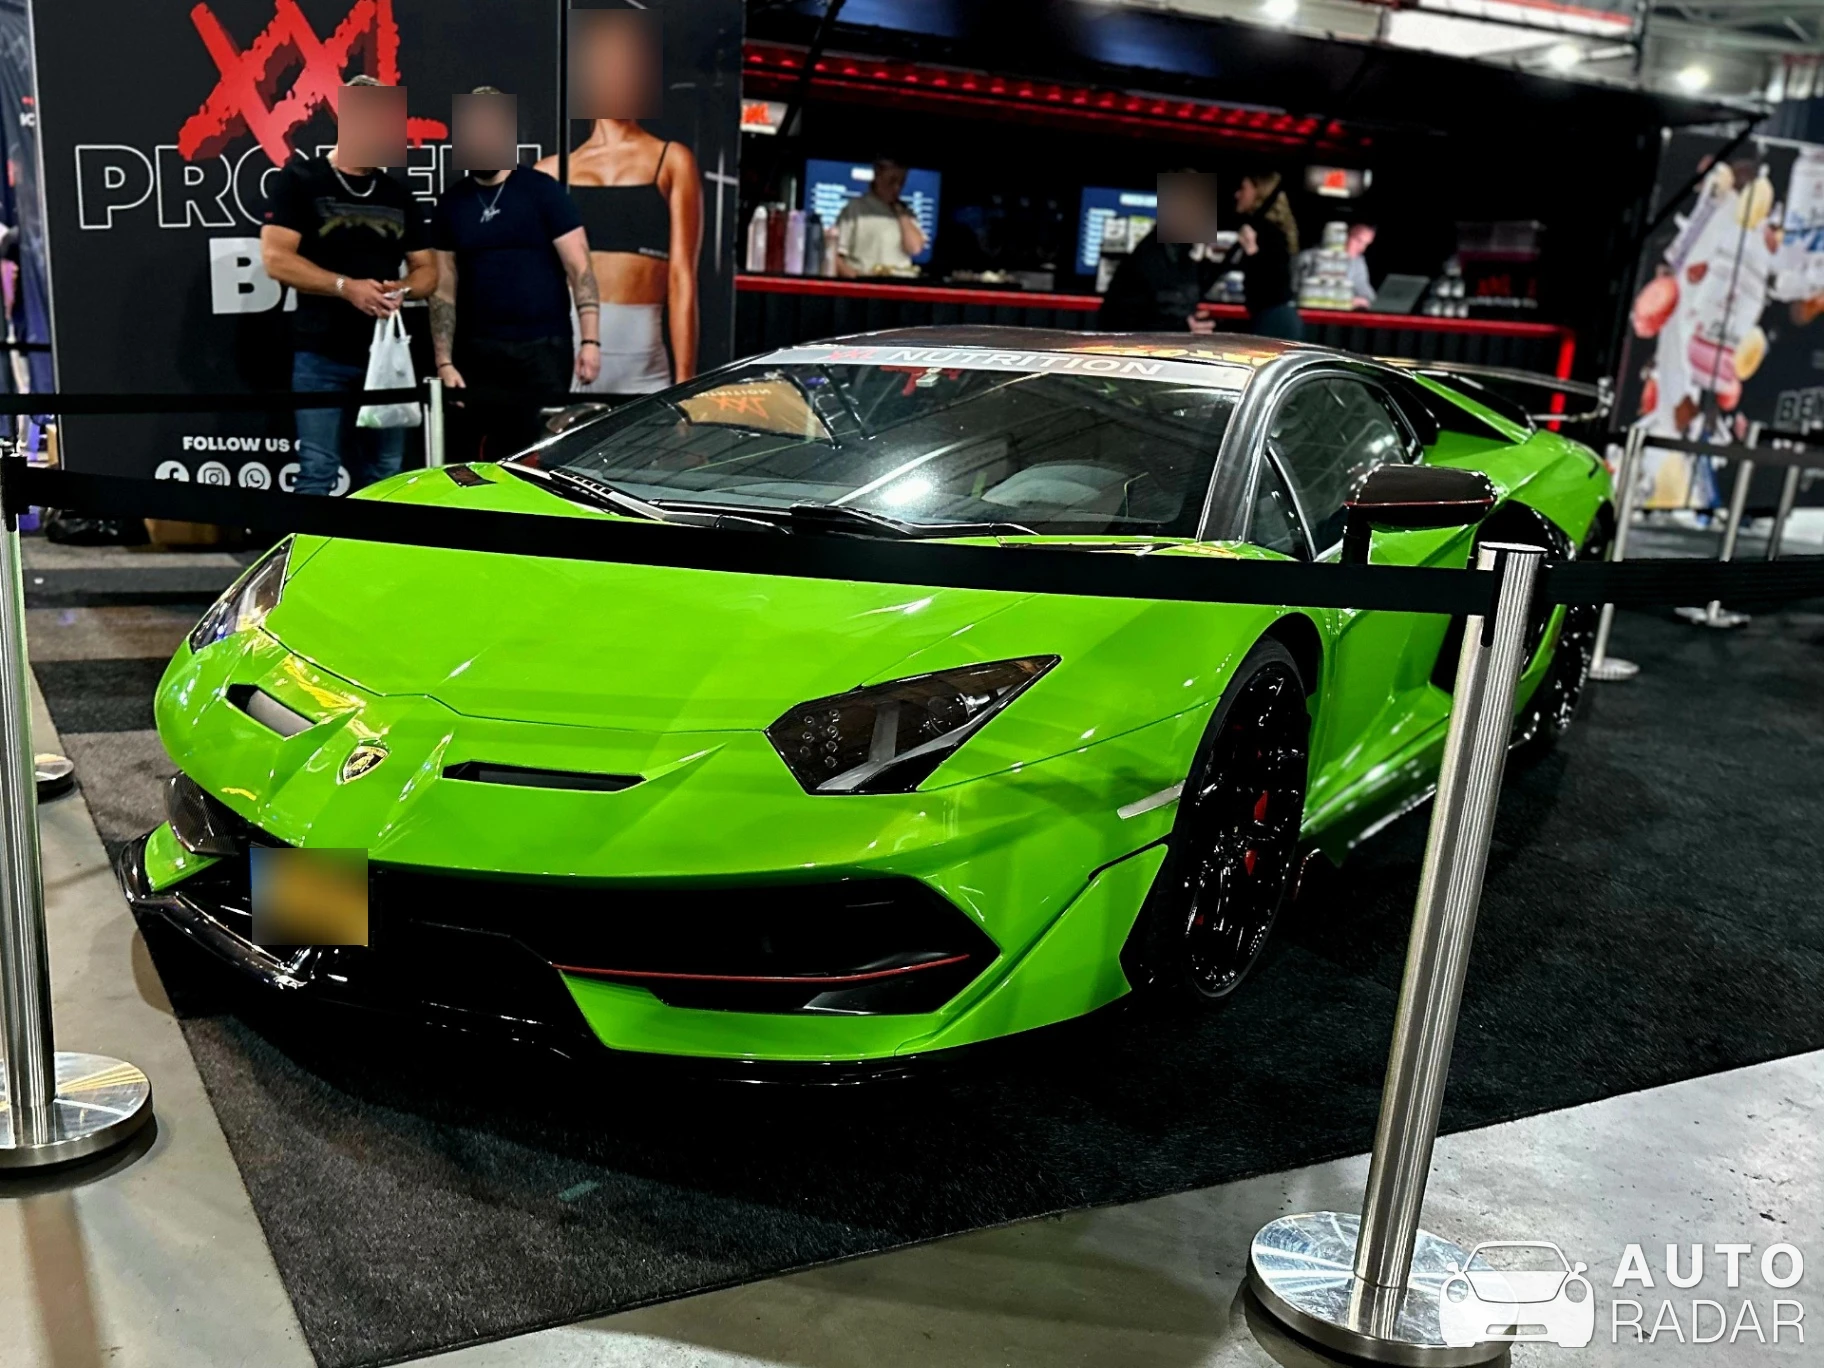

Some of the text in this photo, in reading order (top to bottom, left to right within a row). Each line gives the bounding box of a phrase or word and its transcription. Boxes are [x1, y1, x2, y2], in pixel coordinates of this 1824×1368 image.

[886, 350, 1165, 376] NUTRITION
[183, 436, 260, 451] FOLLOW
[265, 438, 290, 451] US
